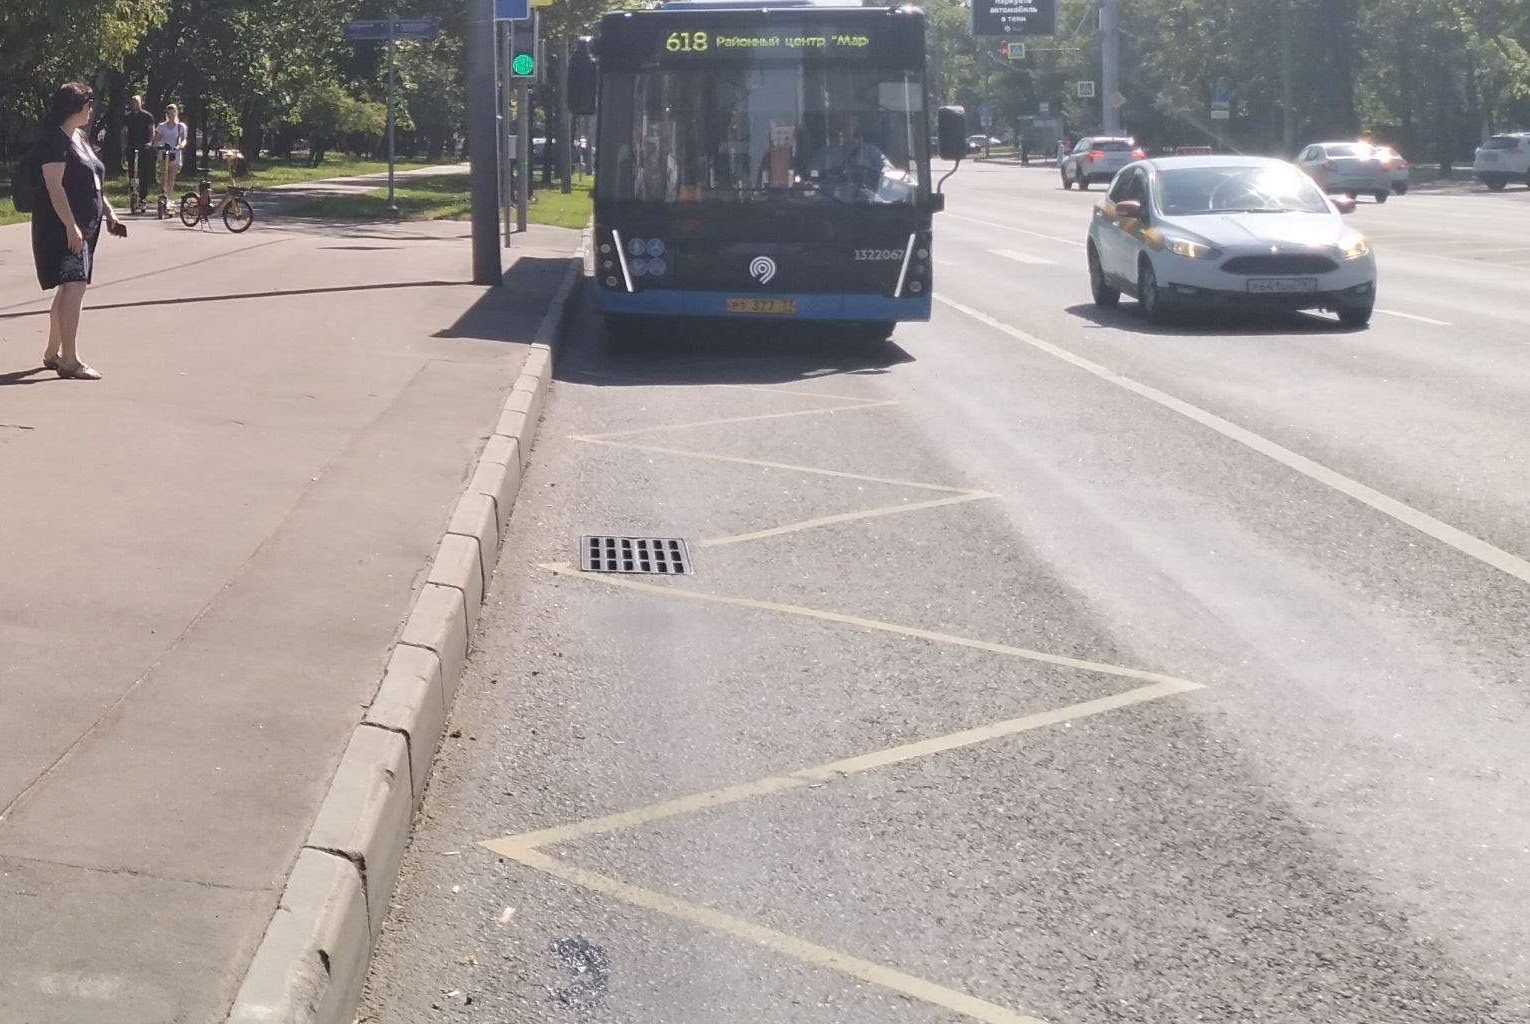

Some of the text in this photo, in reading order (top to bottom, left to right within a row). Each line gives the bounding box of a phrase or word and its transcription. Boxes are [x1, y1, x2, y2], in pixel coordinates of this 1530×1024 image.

[666, 32, 708, 51] 618
[716, 36, 780, 47] Районный
[785, 36, 826, 48] центр
[854, 249, 905, 260] 1322067
